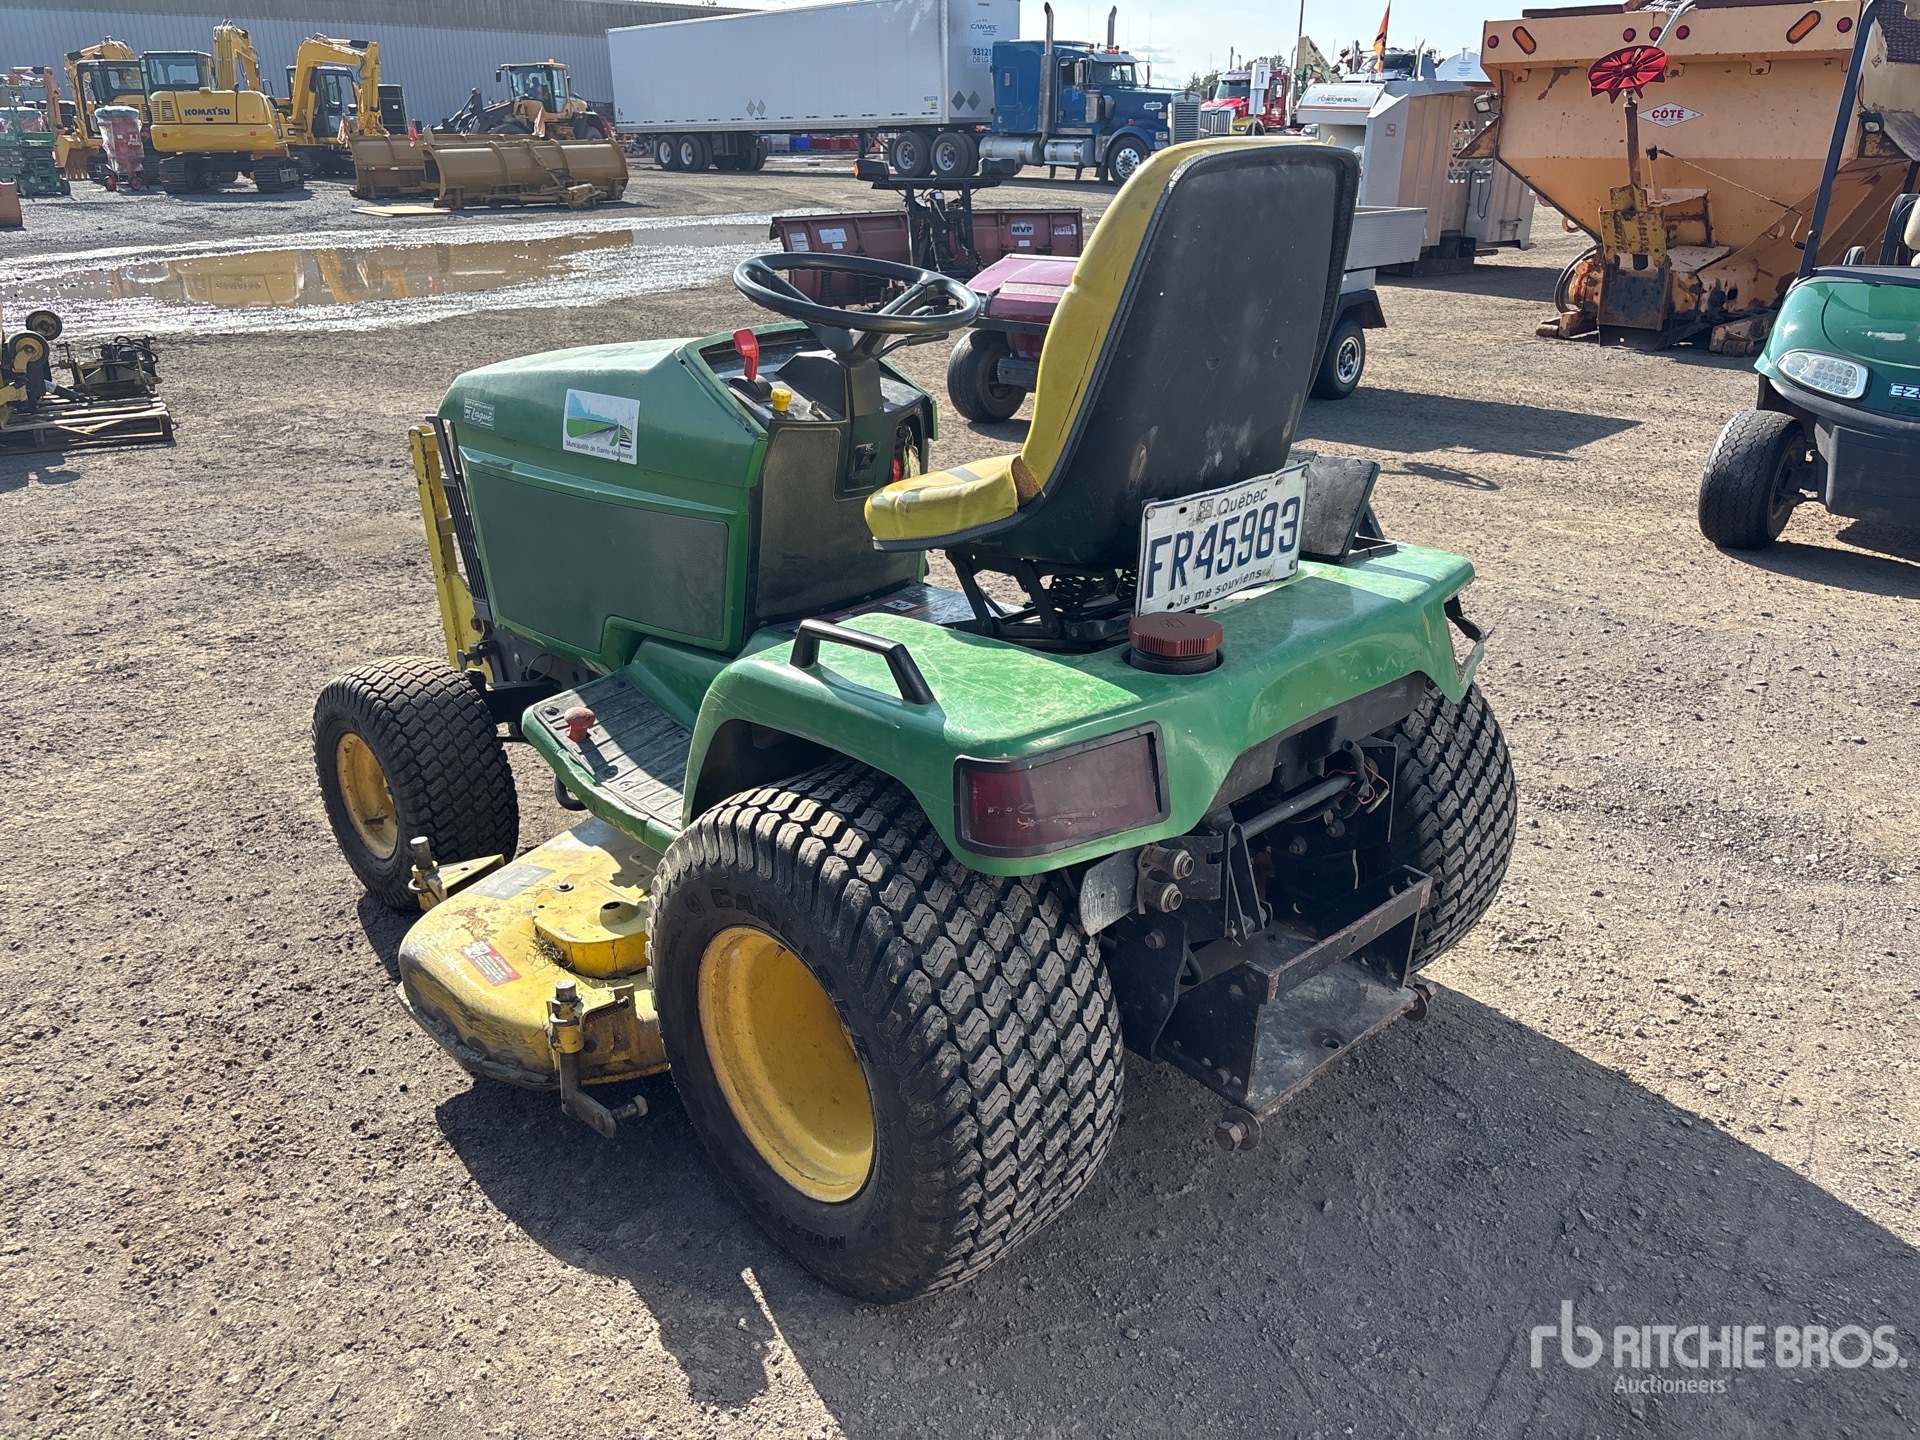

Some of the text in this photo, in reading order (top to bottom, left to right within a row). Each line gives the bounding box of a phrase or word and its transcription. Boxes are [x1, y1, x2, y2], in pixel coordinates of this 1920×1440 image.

[970, 23, 998, 31] CANVEC
[1260, 71, 1265, 84] 1
[184, 106, 231, 117] KOMATSU
[1652, 107, 1685, 119] CÔTÉ
[1890, 385, 1920, 399] EZ
[566, 439, 590, 452] Municipalité
[590, 444, 596, 452] de
[1217, 486, 1269, 516] Québec
[1146, 495, 1301, 598] FR45983
[1176, 569, 1263, 607] Je me souviens
